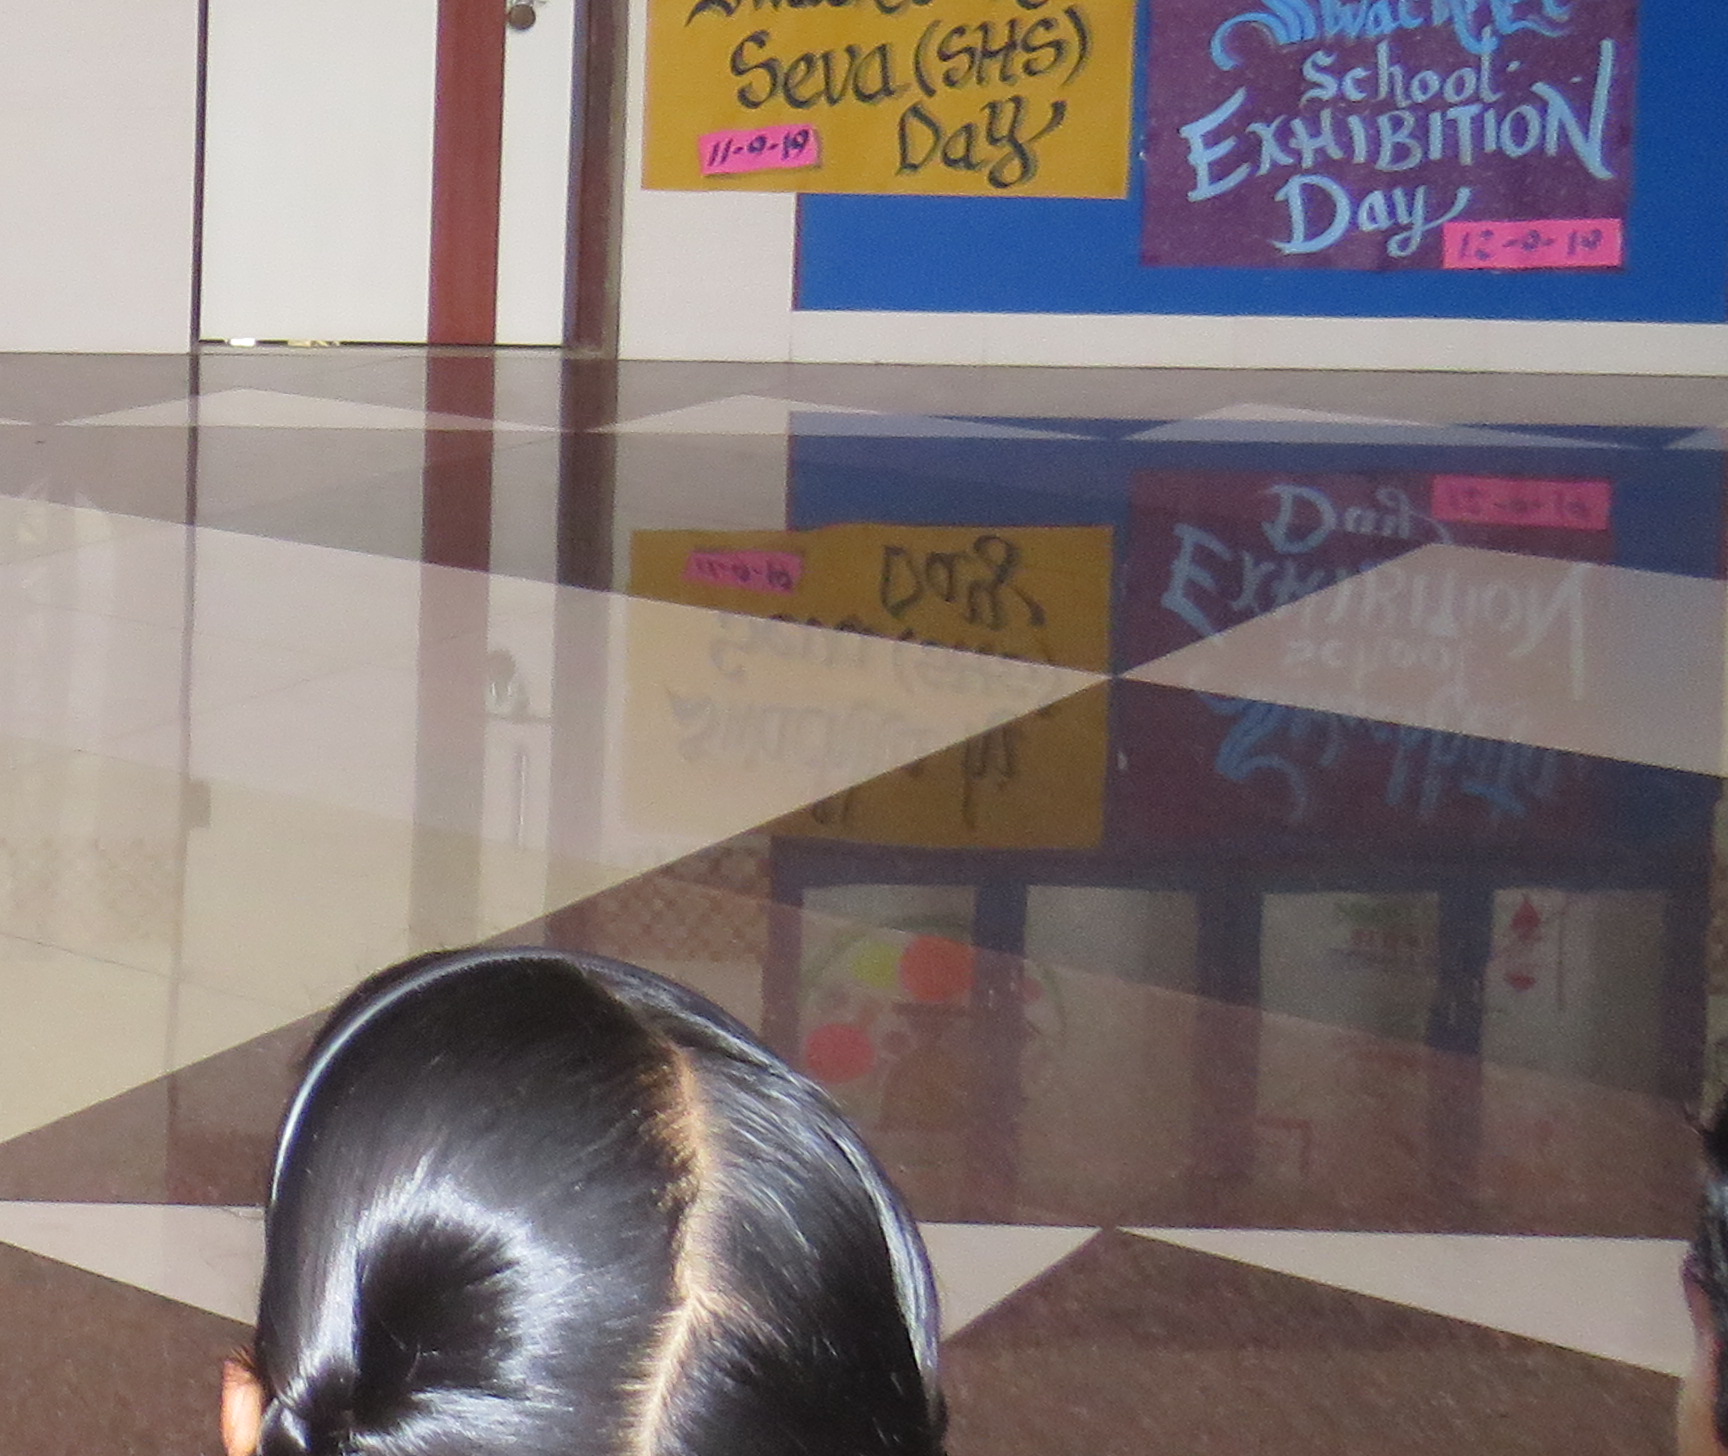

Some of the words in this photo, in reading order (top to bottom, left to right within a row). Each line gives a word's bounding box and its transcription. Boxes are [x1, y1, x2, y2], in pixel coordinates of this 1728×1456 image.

[895, 95, 1068, 190] Day
[1179, 39, 1614, 203] EXHIBITION
[1269, 174, 1475, 258] Day
